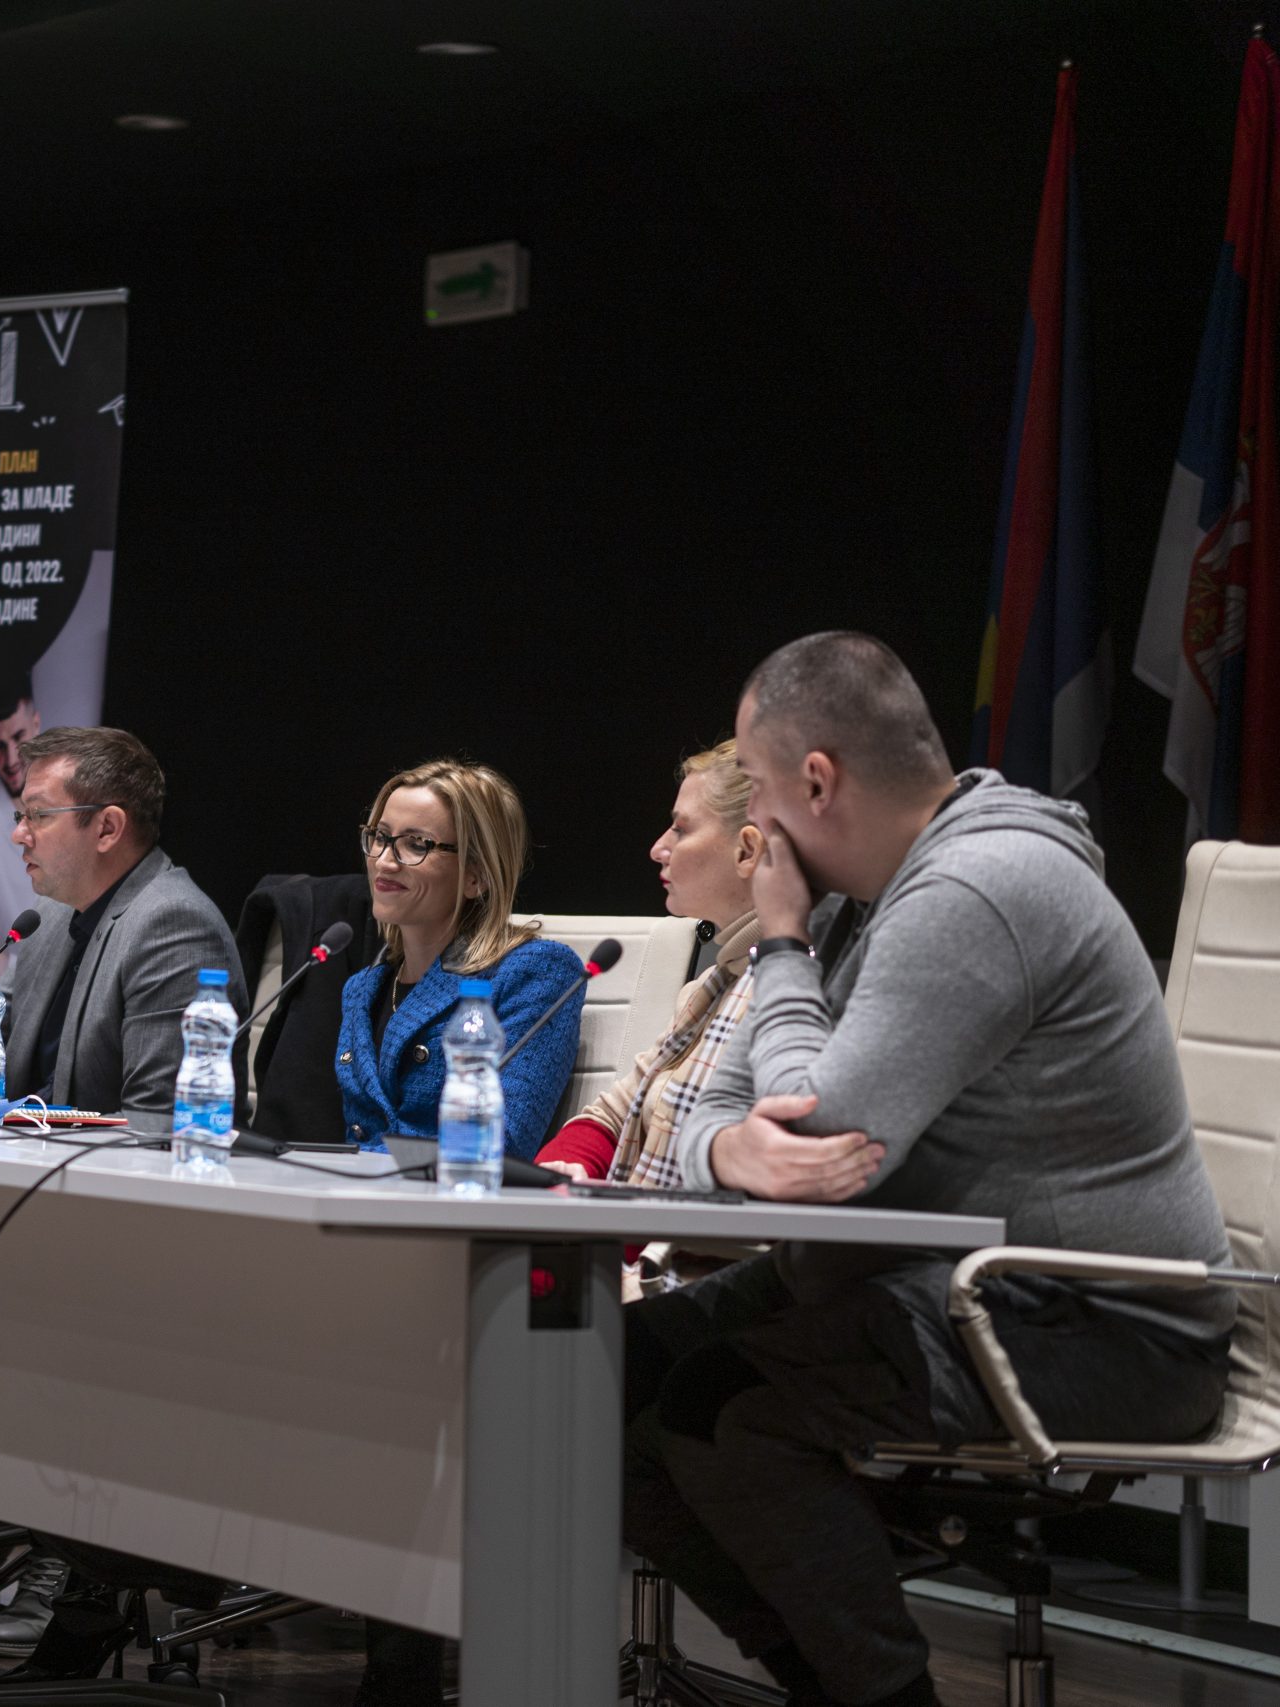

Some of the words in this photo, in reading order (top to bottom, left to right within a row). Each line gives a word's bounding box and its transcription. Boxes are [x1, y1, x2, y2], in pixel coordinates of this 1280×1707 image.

[0, 488, 19, 510] ЗА
[22, 485, 74, 512] МЛАДЕ
[1, 561, 23, 587] ОД
[25, 560, 64, 583] 2022.
